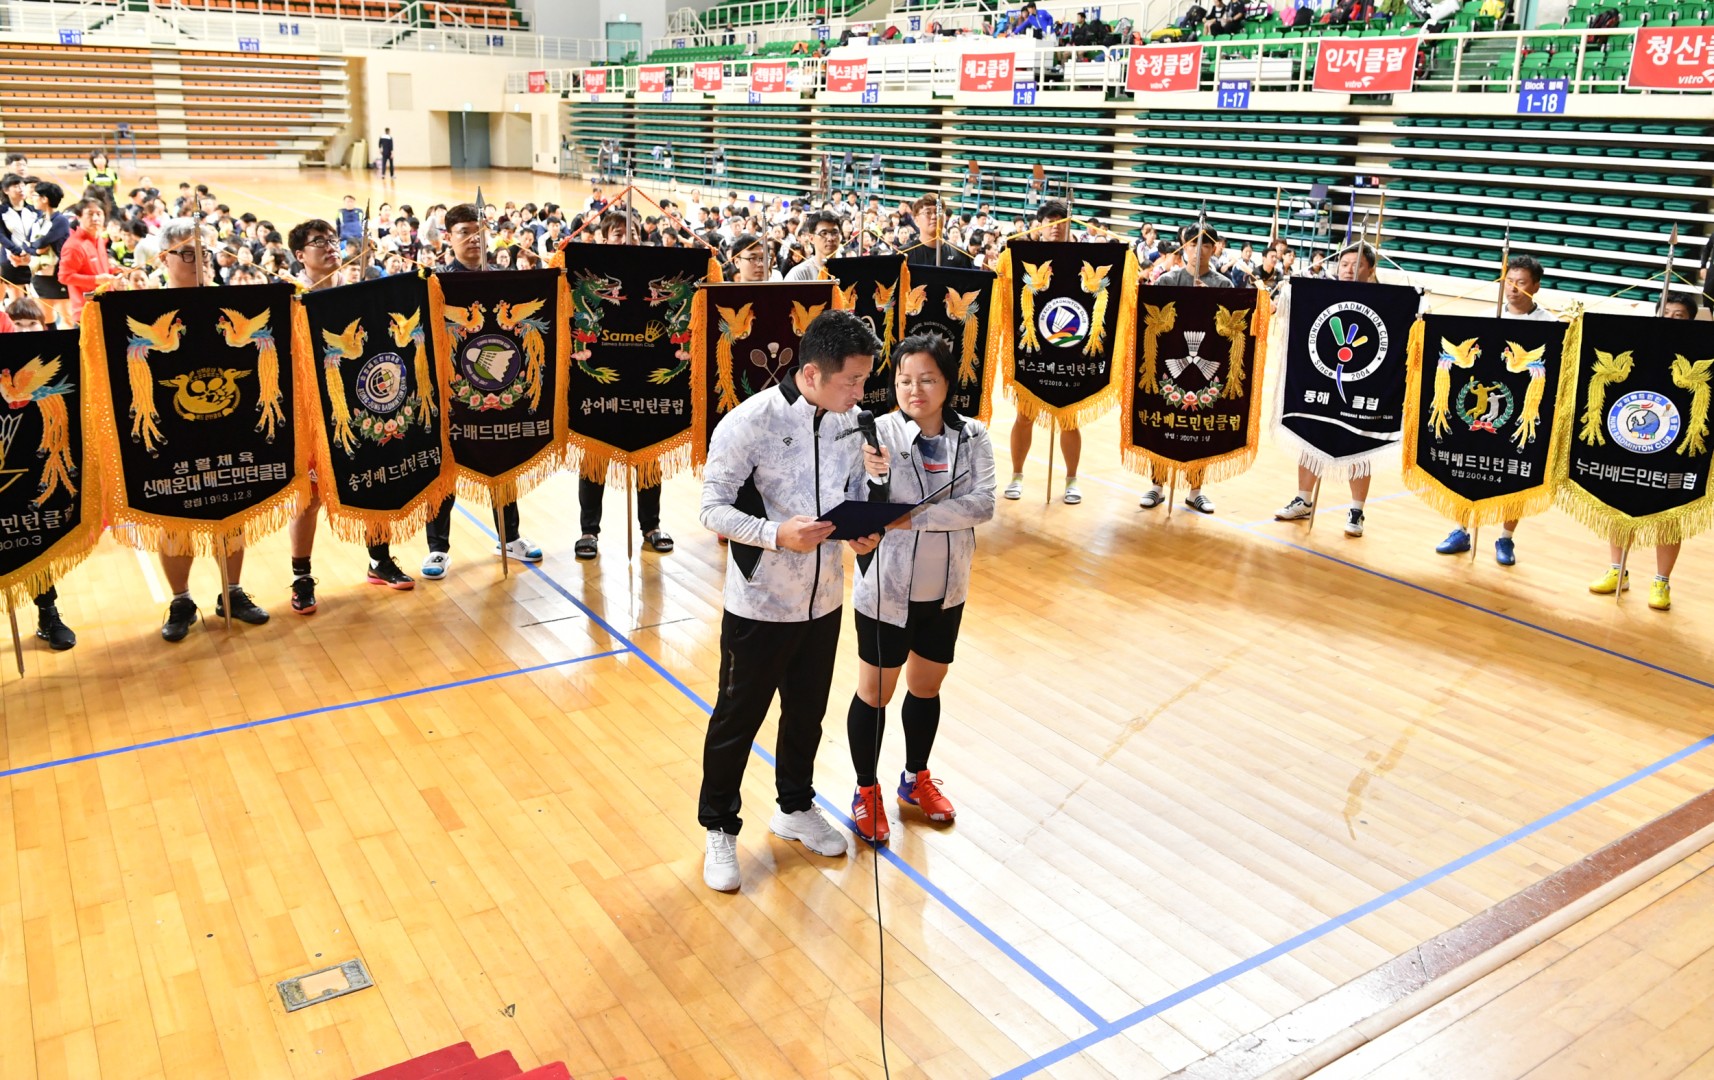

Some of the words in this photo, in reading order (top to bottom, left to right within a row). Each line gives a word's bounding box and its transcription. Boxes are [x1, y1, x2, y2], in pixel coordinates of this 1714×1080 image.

[1134, 53, 1194, 77] 송정클럽
[1325, 47, 1407, 73] 인지클럽
[1524, 81, 1544, 90] Block
[1678, 75, 1704, 84] vitro
[1016, 91, 1032, 104] 1-16
[1223, 92, 1245, 107] 1-17
[1526, 94, 1558, 112] 1-18
[1337, 303, 1384, 328] BADMINTON
[1379, 330, 1387, 352] CLUB
[1018, 359, 1105, 376] 벡스코배드민턴클럽
[1314, 359, 1333, 377] Since
[1351, 368, 1371, 380] 2004
[580, 397, 684, 416] 삼어배드민턴클럽
[1304, 390, 1330, 405] 동해
[1352, 396, 1379, 411] 클럽
[1138, 410, 1241, 431] 반산배드민턴클럽
[1613, 431, 1654, 451] BADMINTON
[1655, 436, 1672, 450] CLUB
[349, 447, 442, 491] 송정배드민턴클럽
[1430, 447, 1532, 478] 동백배드민턴클럽
[1576, 458, 1697, 490] 누리배드민턴클럽
